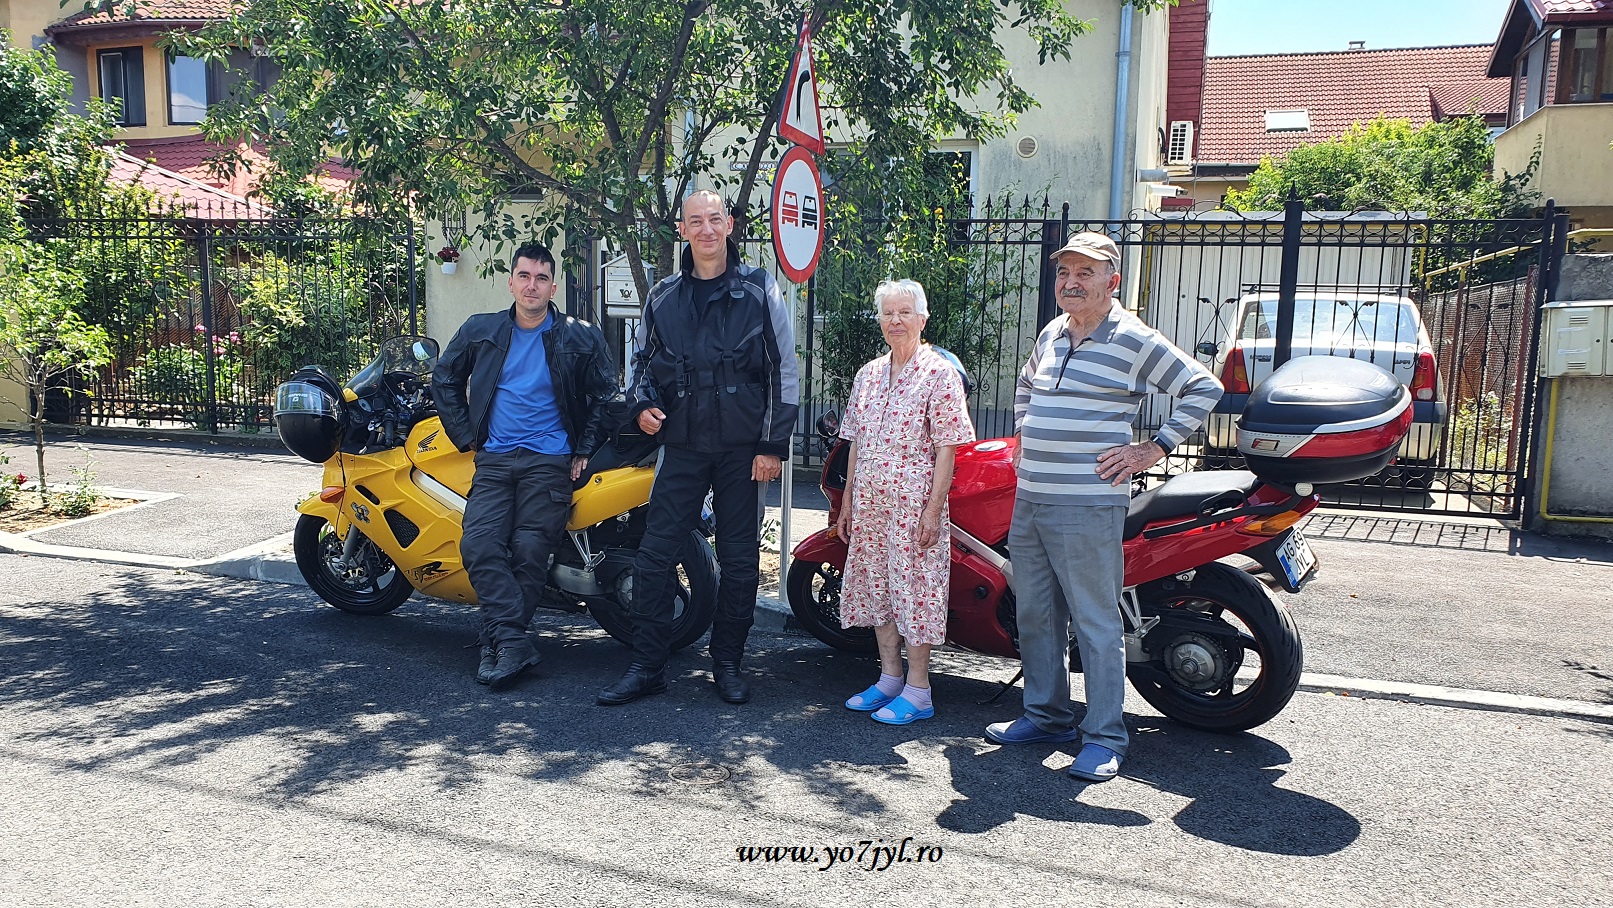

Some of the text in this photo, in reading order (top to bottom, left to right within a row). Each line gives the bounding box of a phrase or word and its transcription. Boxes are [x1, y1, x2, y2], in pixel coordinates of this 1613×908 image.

[1283, 542, 1295, 562] AG
[1292, 531, 1304, 550] 69
[1295, 552, 1310, 575] JYL
